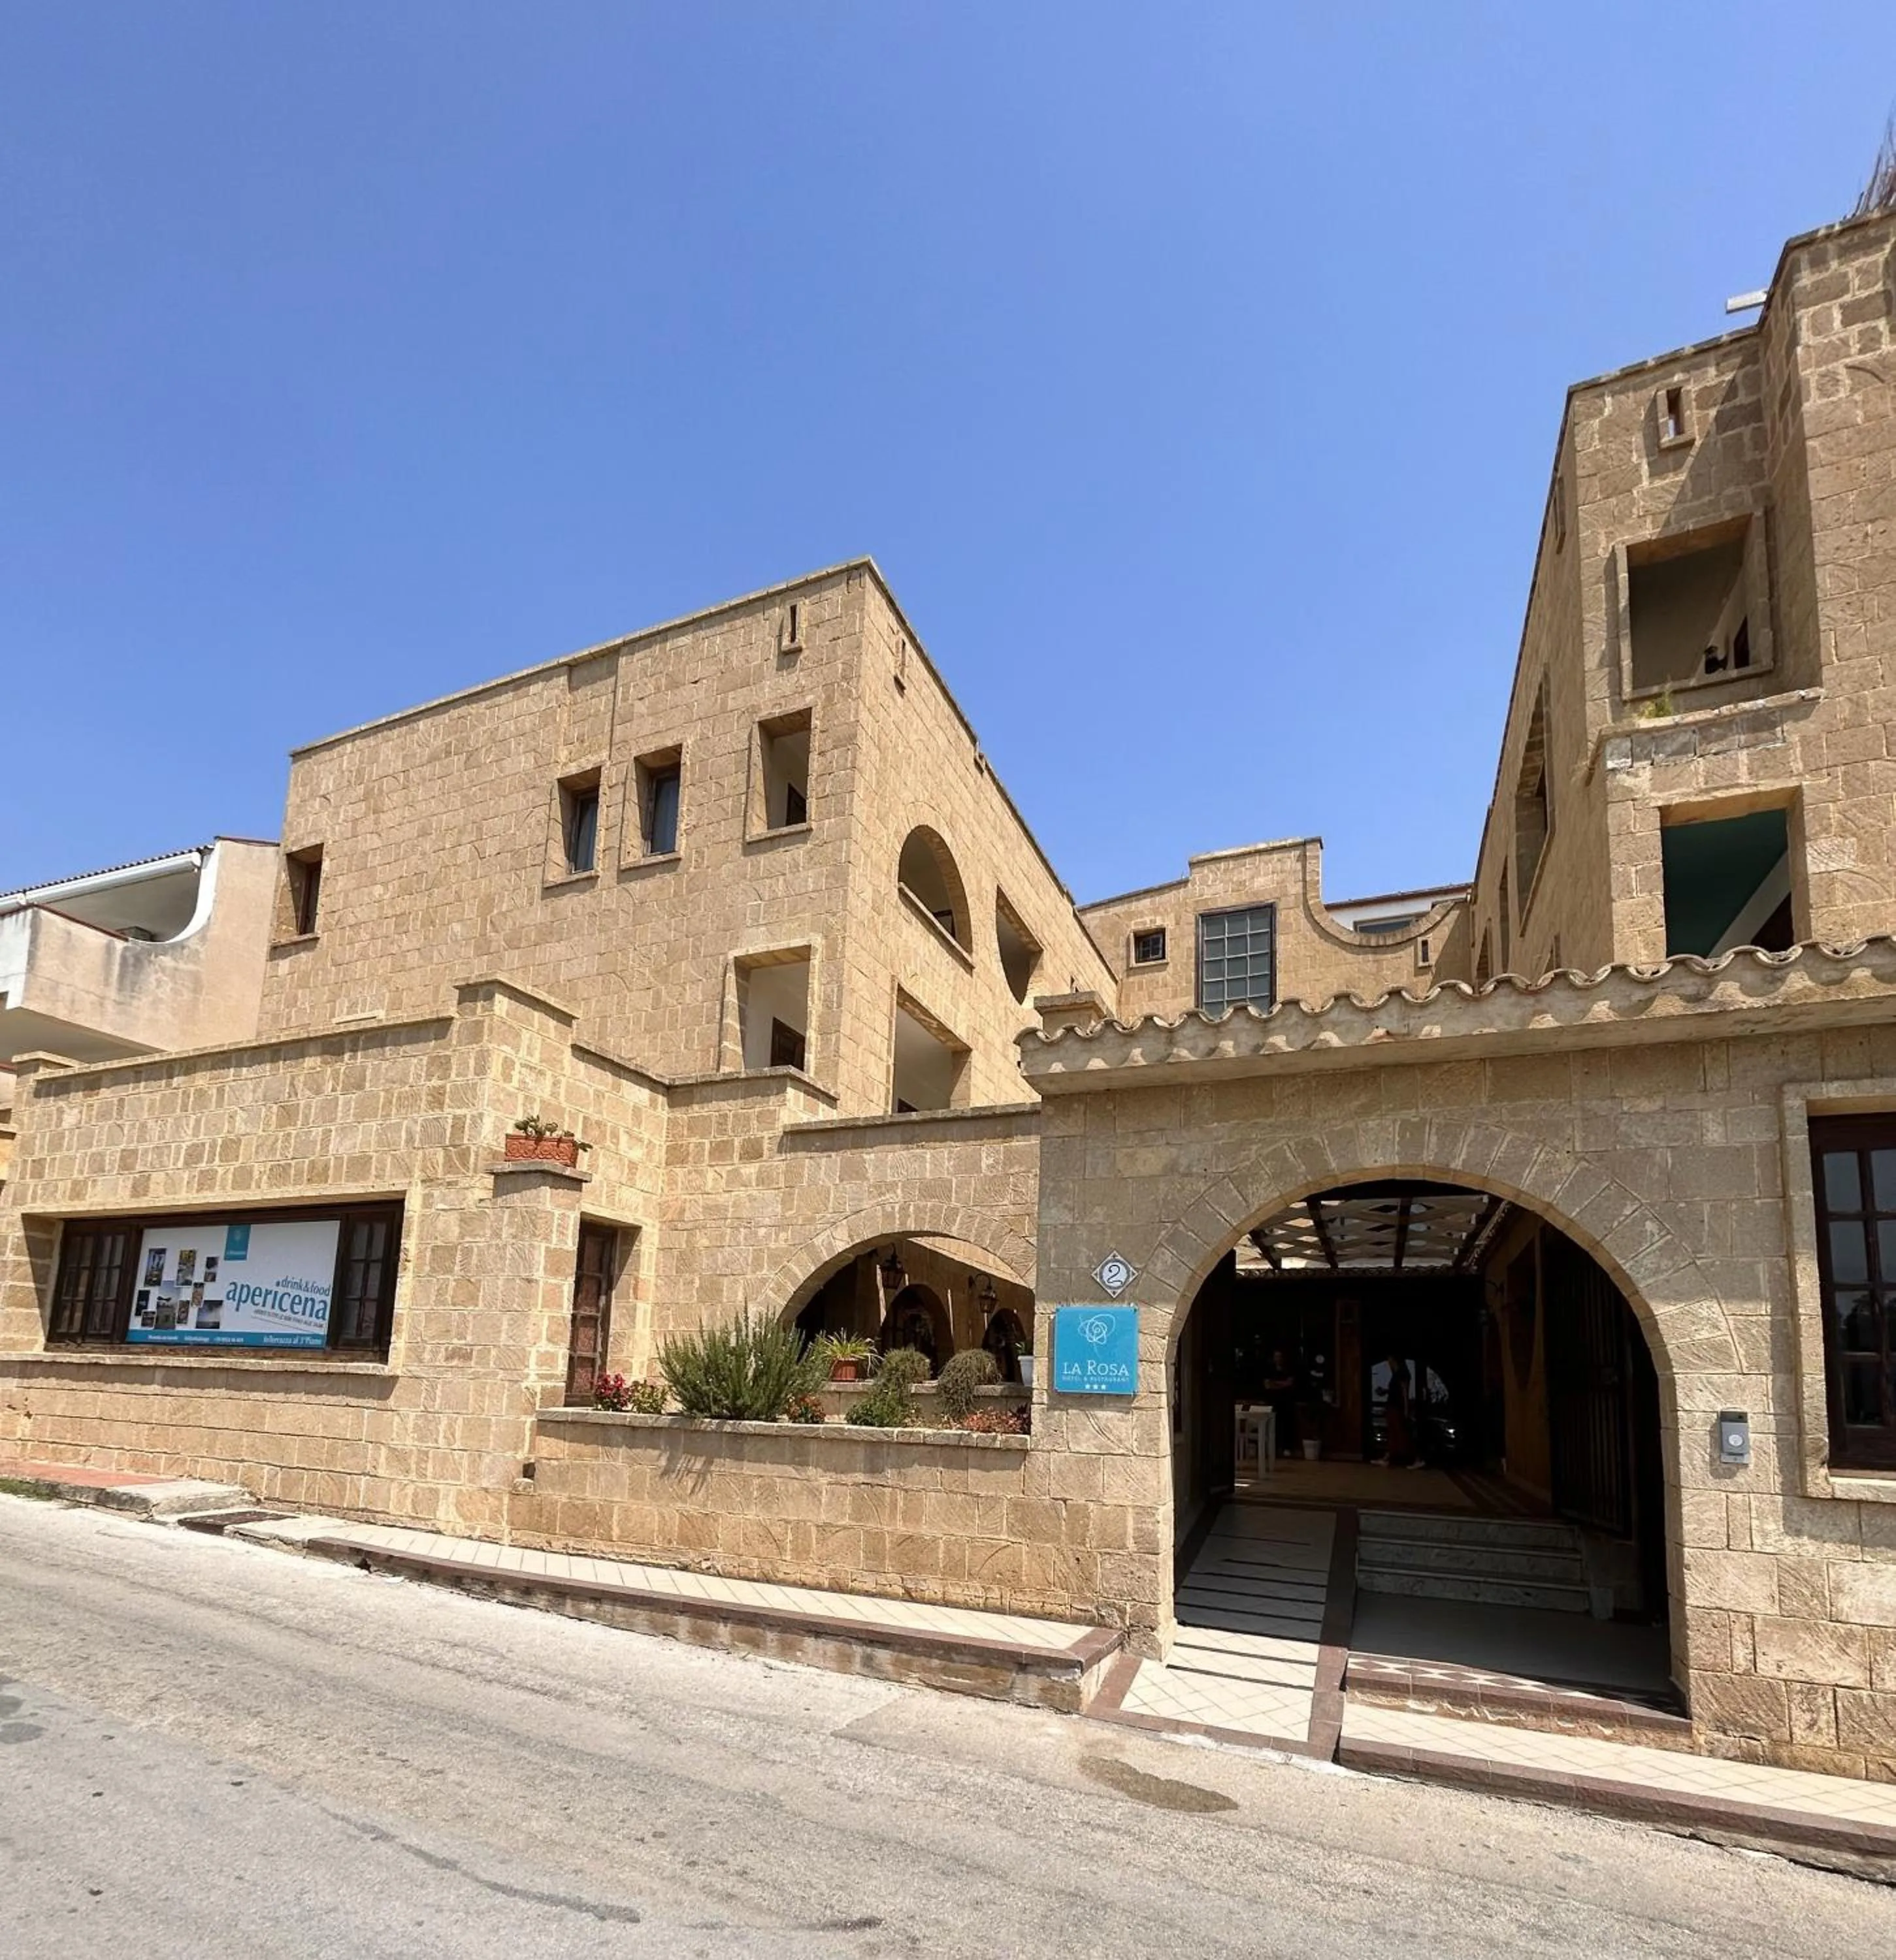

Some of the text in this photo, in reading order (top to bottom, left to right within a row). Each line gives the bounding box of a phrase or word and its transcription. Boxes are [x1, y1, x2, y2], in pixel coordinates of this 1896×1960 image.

[1107, 1264, 1123, 1285] 2
[226, 1279, 327, 1320] apericena
[1062, 1362, 1082, 1375] LA
